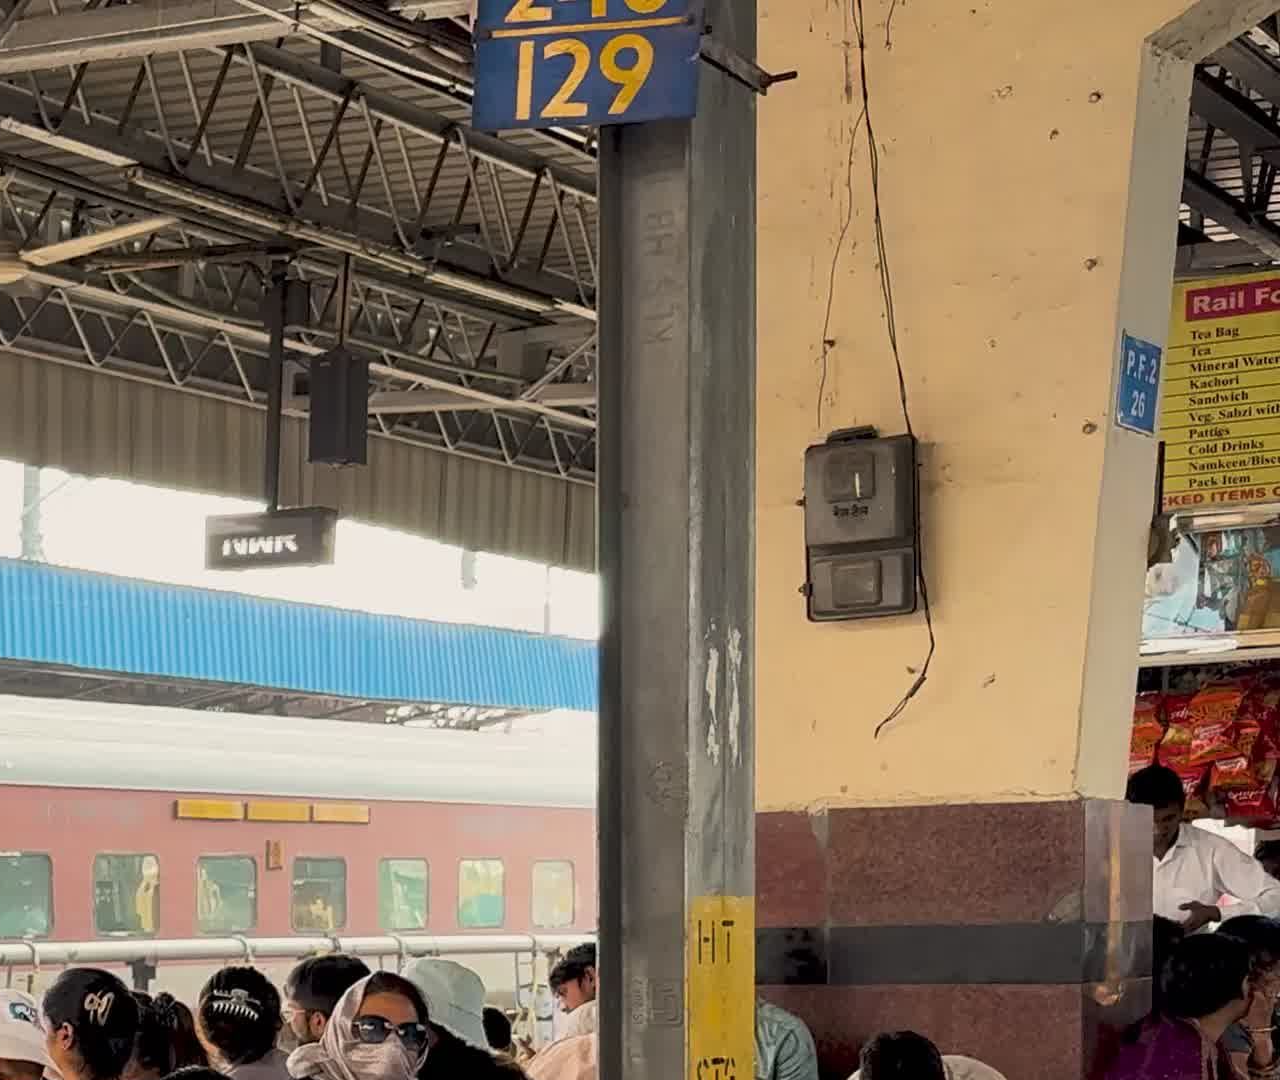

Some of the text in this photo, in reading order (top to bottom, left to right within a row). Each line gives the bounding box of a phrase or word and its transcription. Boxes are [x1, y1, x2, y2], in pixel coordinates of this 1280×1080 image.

[516, 33, 655, 121] 129
[1193, 289, 1245, 314] Rail
[1191, 327, 1240, 340] Tea Bag
[1192, 346, 1211, 357] Tea
[1191, 358, 1239, 373] Mineral
[1189, 375, 1239, 390] Kachori
[1131, 391, 1145, 418] 26
[1189, 391, 1248, 406] Sandwich
[1219, 406, 1252, 419] Sabzi
[1188, 439, 1264, 456] Cold Drinks
[1188, 474, 1251, 488] Pack Item
[1211, 487, 1267, 502] ITEMS
[698, 919, 735, 965] HT
